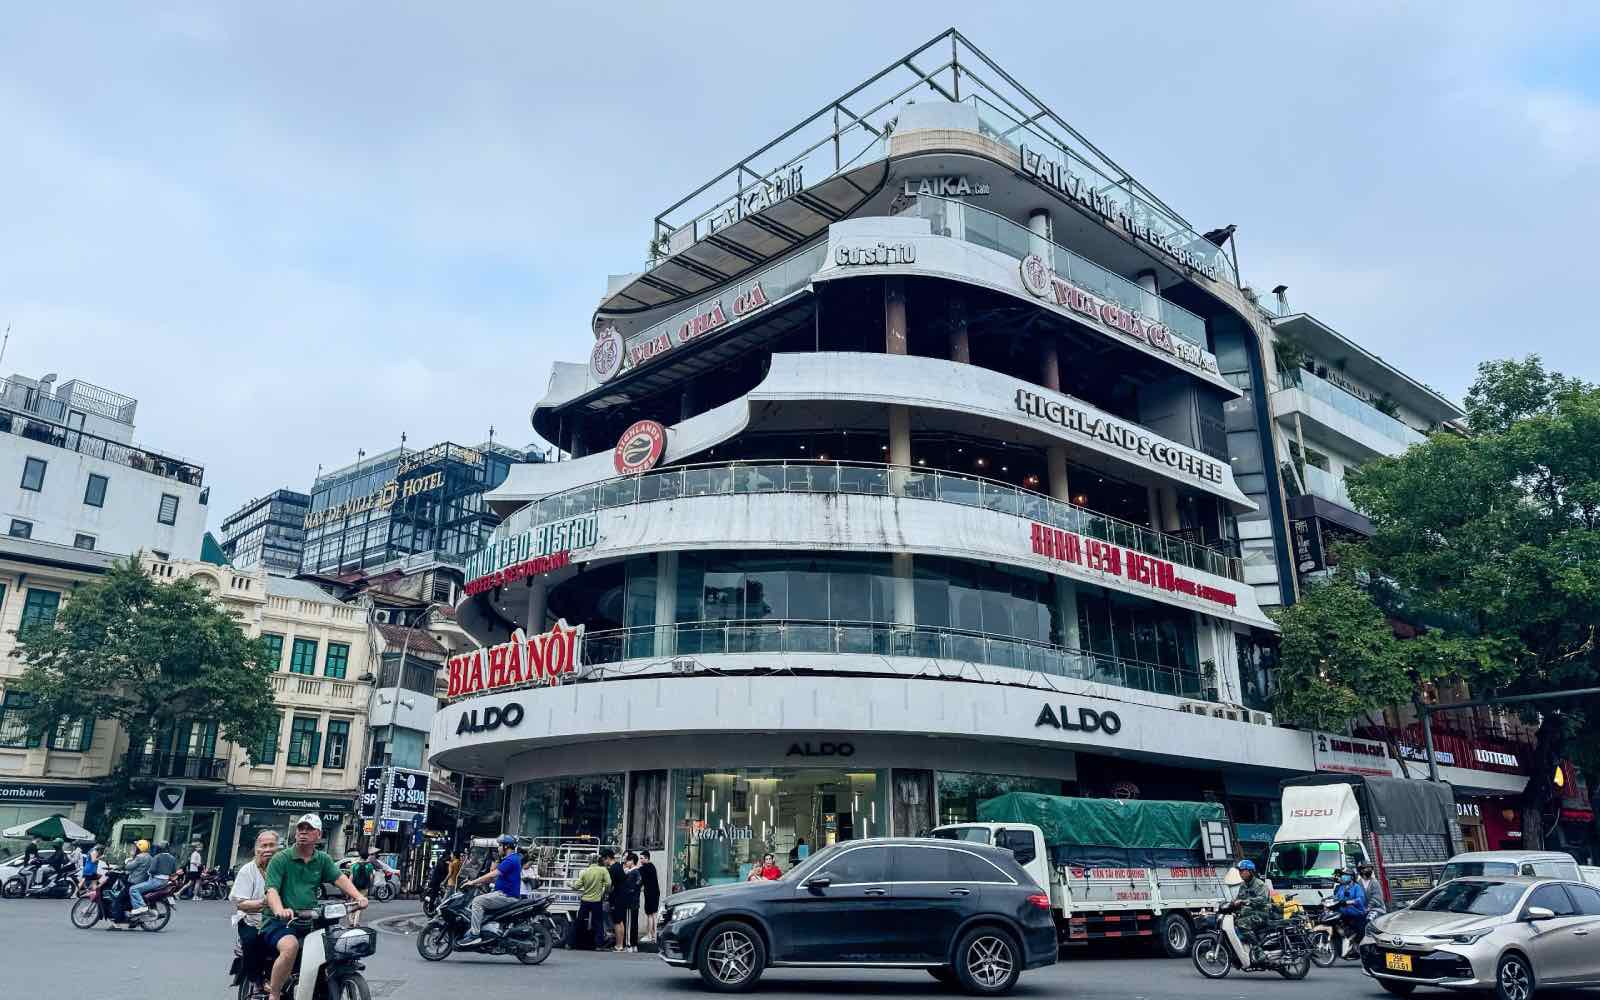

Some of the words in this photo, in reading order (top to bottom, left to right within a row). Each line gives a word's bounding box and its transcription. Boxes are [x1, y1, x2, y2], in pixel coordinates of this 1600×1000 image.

[904, 175, 972, 196] LAIKA
[706, 184, 772, 237] LAIKA
[1021, 143, 1090, 208] LAIKA
[1119, 210, 1149, 242] The
[1148, 230, 1217, 283] Exceptional
[1051, 275, 1099, 321] VUA
[631, 331, 672, 367] VUA
[1014, 388, 1150, 456] HIGHLANDS
[1150, 443, 1222, 484] COFFEE
[402, 471, 445, 497] HOTEL
[536, 516, 600, 559] BISTRO
[1085, 537, 1122, 576] 1930
[447, 650, 484, 698] BIA
[487, 631, 522, 688] HÀ
[525, 623, 578, 688] NỘI
[456, 702, 525, 735] ALDO
[1035, 703, 1122, 735] ALDO
[785, 742, 856, 757] ALDO
[1475, 749, 1519, 767] LOTTERIA
[0, 787, 46, 798] ombank
[272, 798, 320, 808] Vietcombank
[363, 793, 382, 805] SP
[393, 787, 406, 802] FS
[406, 789, 426, 805] SPA
[1290, 808, 1334, 817] ISUZU
[1456, 803, 1480, 817] DAYS
